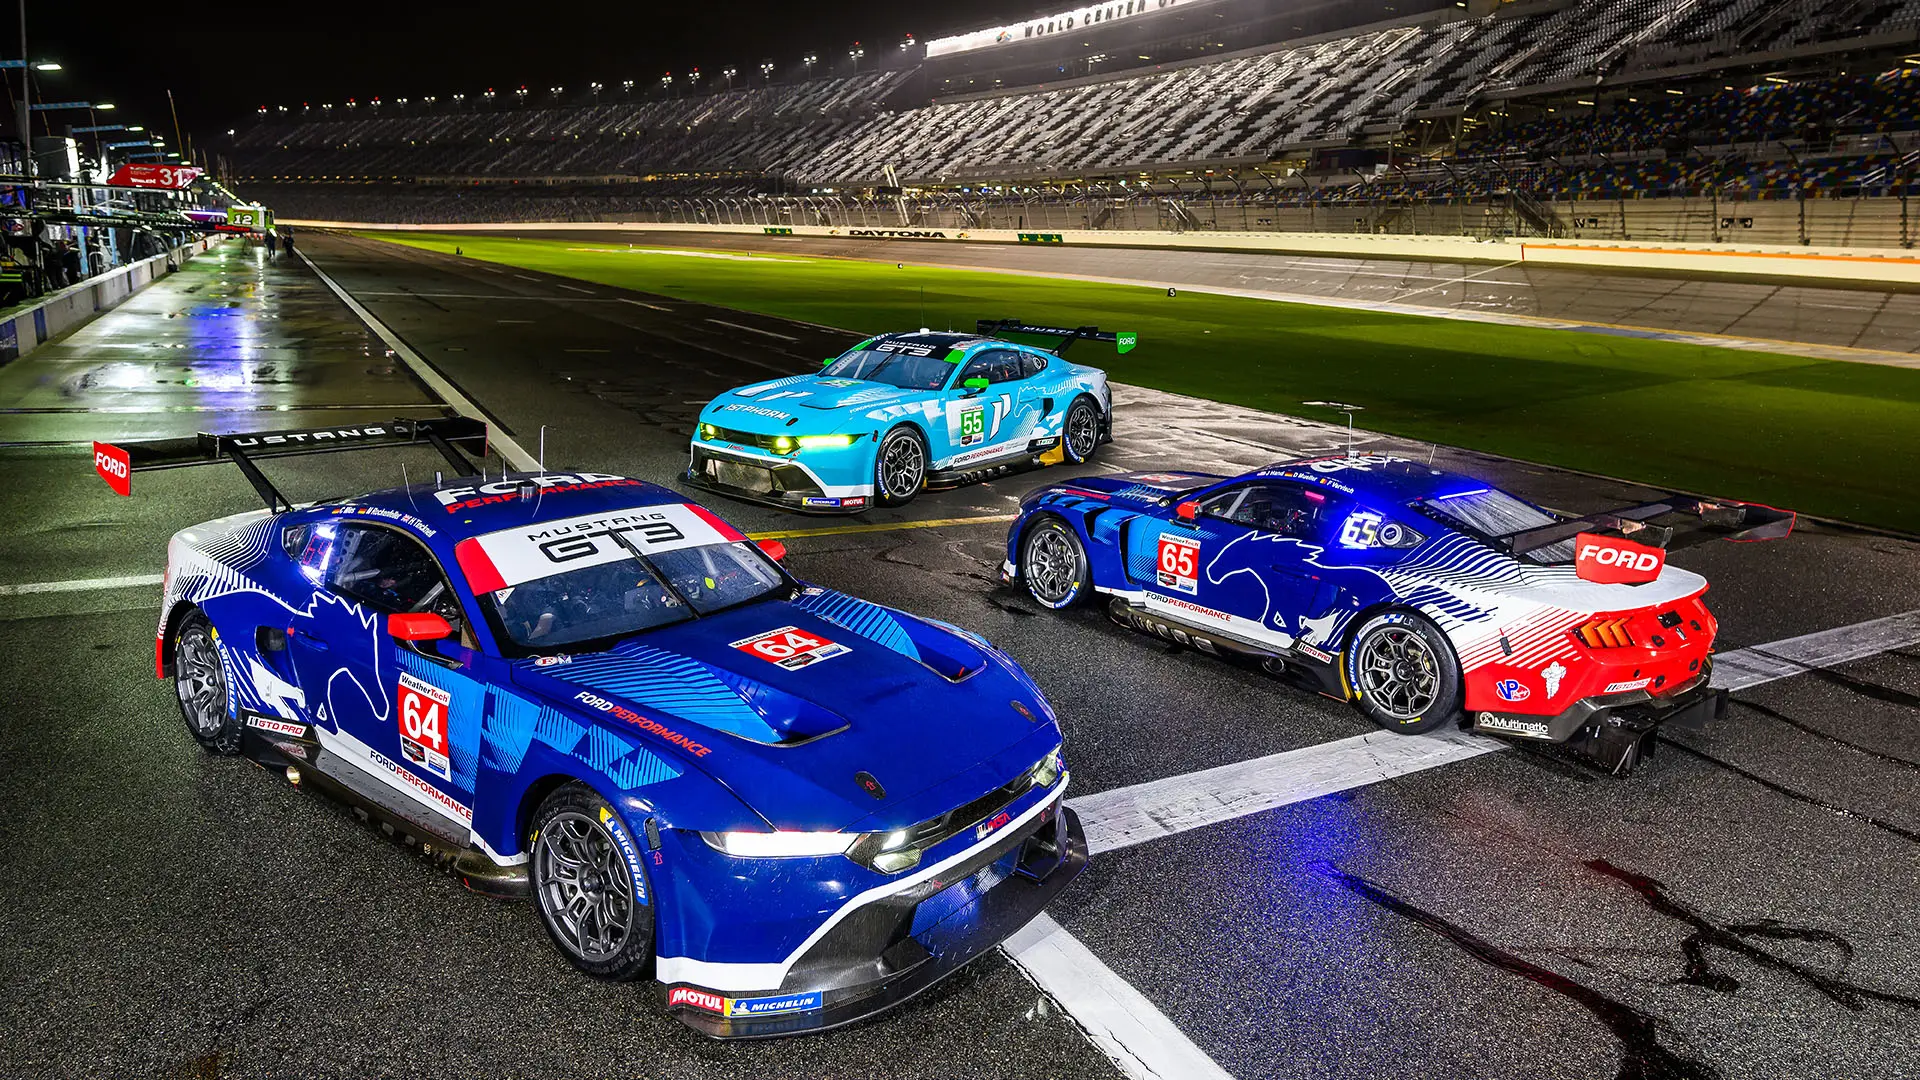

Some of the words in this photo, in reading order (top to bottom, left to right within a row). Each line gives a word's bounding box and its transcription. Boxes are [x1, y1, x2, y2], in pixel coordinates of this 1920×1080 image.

[1024, 17, 1074, 38] WORLD
[1084, 0, 1145, 25] CENTER
[160, 168, 183, 187] 31
[234, 215, 253, 225] 12
[849, 229, 947, 239] DAYTONA
[875, 343, 933, 357] GT3
[884, 339, 937, 349] MUSTANG
[1118, 336, 1135, 346] FORD
[963, 411, 982, 435] 55
[234, 427, 386, 446] USTANG
[95, 452, 127, 479] FORD
[433, 472, 626, 506] FORD
[445, 479, 643, 515] PERFRMANCE
[527, 513, 666, 542] MUSTANG
[1161, 534, 1199, 547] WeatherTech
[1340, 516, 1379, 545] 65
[539, 522, 685, 563] GT3
[1162, 543, 1193, 576] 65
[1579, 544, 1659, 572] FORD
[753, 632, 821, 658] 64
[1349, 637, 1360, 683] MICHELIN
[220, 648, 236, 713] MICHELIN
[401, 675, 449, 703] WeatherTech
[1497, 680, 1519, 700] VP
[280, 724, 303, 735] PRO
[403, 692, 442, 750] 64
[1494, 716, 1549, 734] Multimatic
[613, 829, 646, 899] MICHELIN
[672, 989, 723, 1010] MOTUL
[750, 997, 815, 1012] MICHELIN
